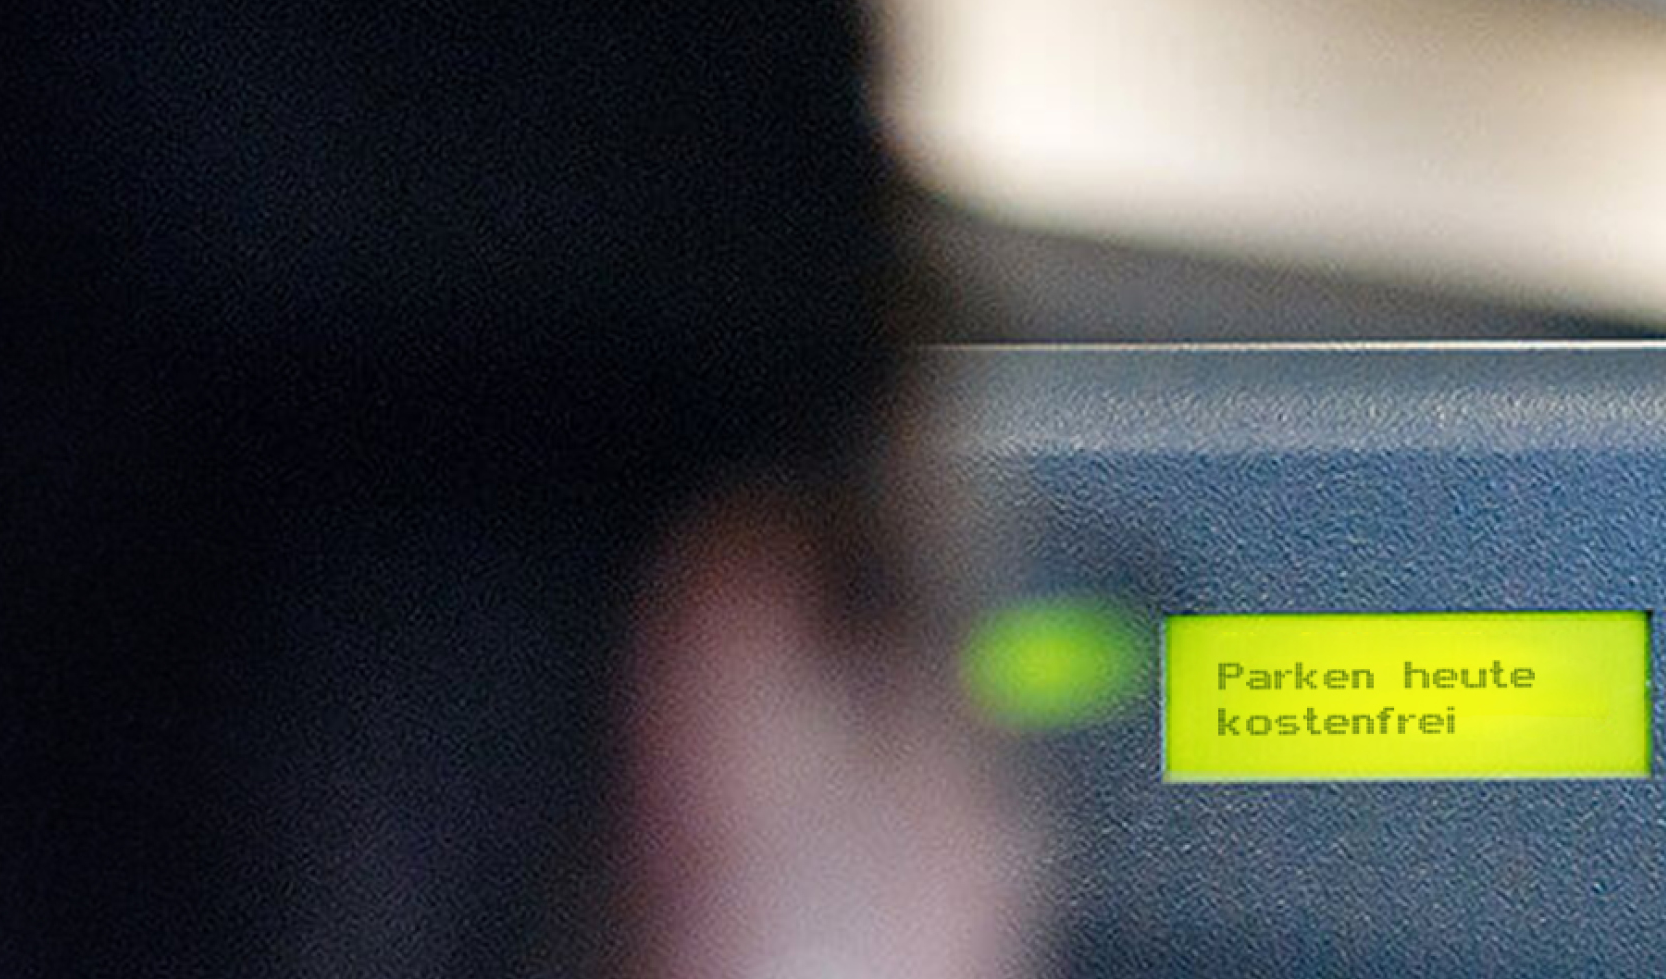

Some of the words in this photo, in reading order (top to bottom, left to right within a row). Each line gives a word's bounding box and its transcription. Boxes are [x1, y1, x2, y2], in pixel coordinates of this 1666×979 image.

[1217, 662, 1374, 690] Parken
[1404, 660, 1536, 690] heute
[1217, 707, 1456, 737] kostenfrei
